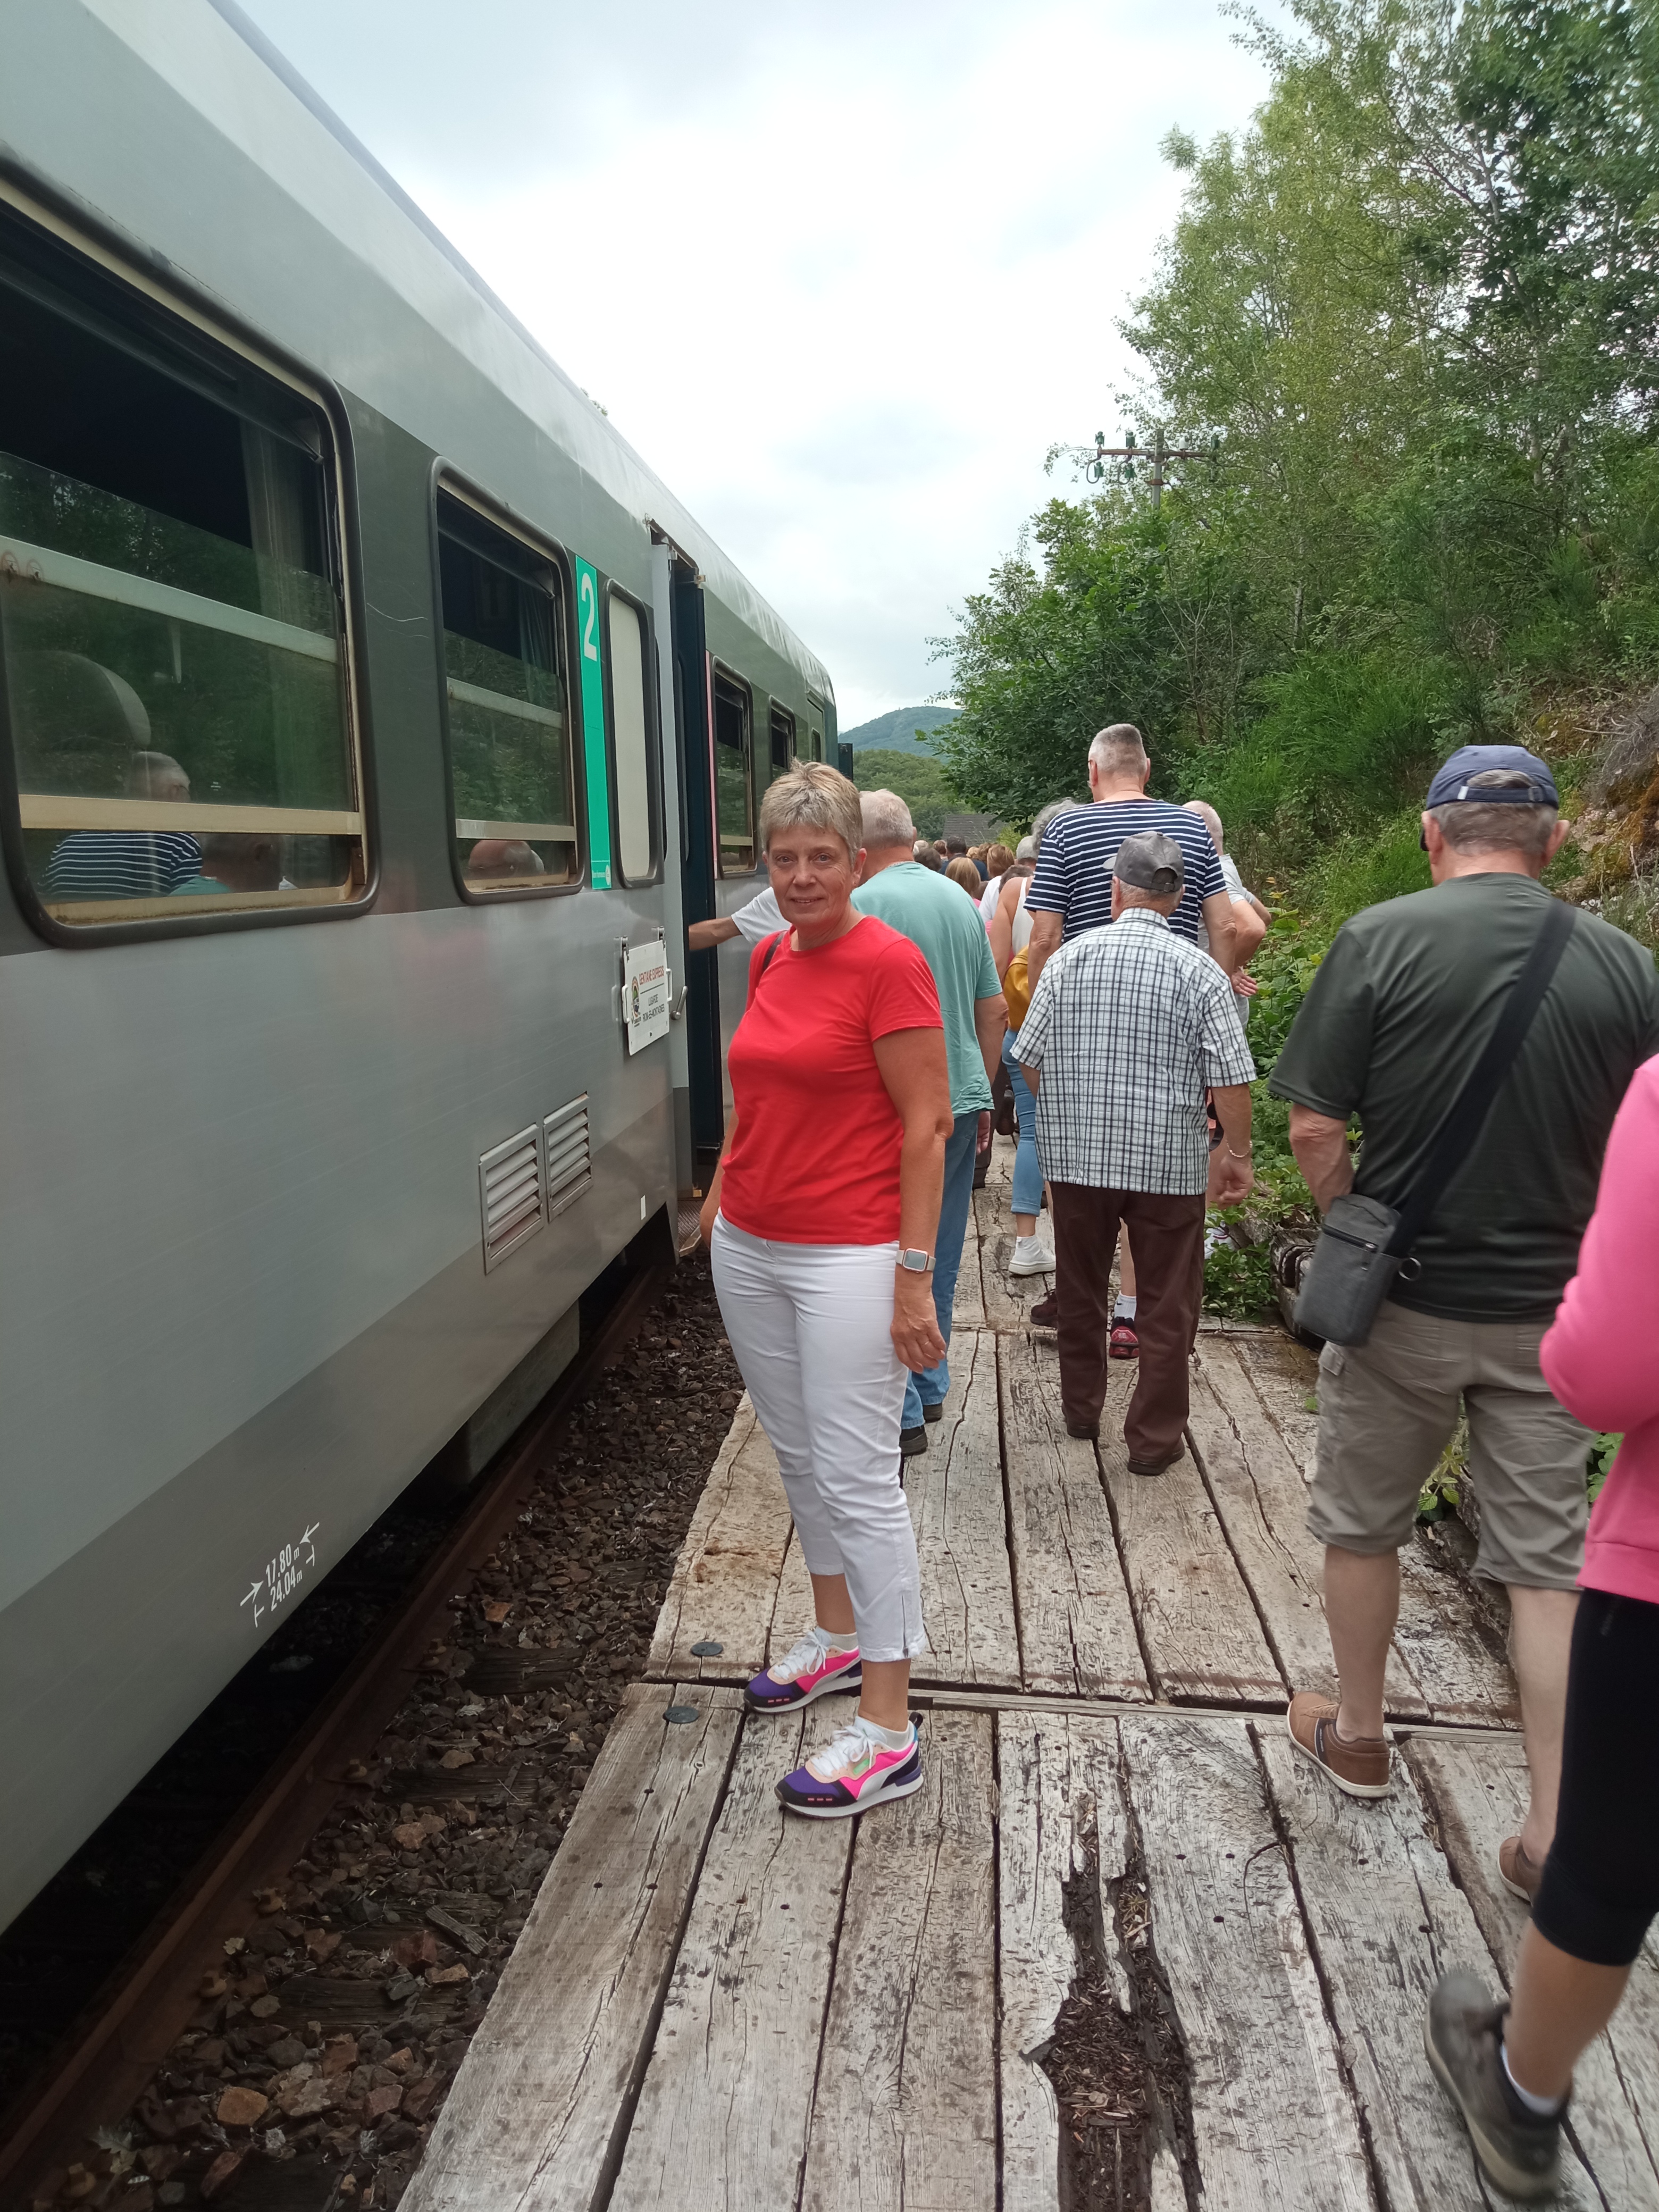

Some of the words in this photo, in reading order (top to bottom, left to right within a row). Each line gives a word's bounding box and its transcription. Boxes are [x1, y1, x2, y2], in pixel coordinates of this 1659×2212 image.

[581, 572, 597, 661] 2
[639, 969, 652, 985] GENTIANE
[652, 965, 664, 980] EXPRESS
[265, 1544, 291, 1587] 17.80
[270, 1565, 296, 1611] 24.04
